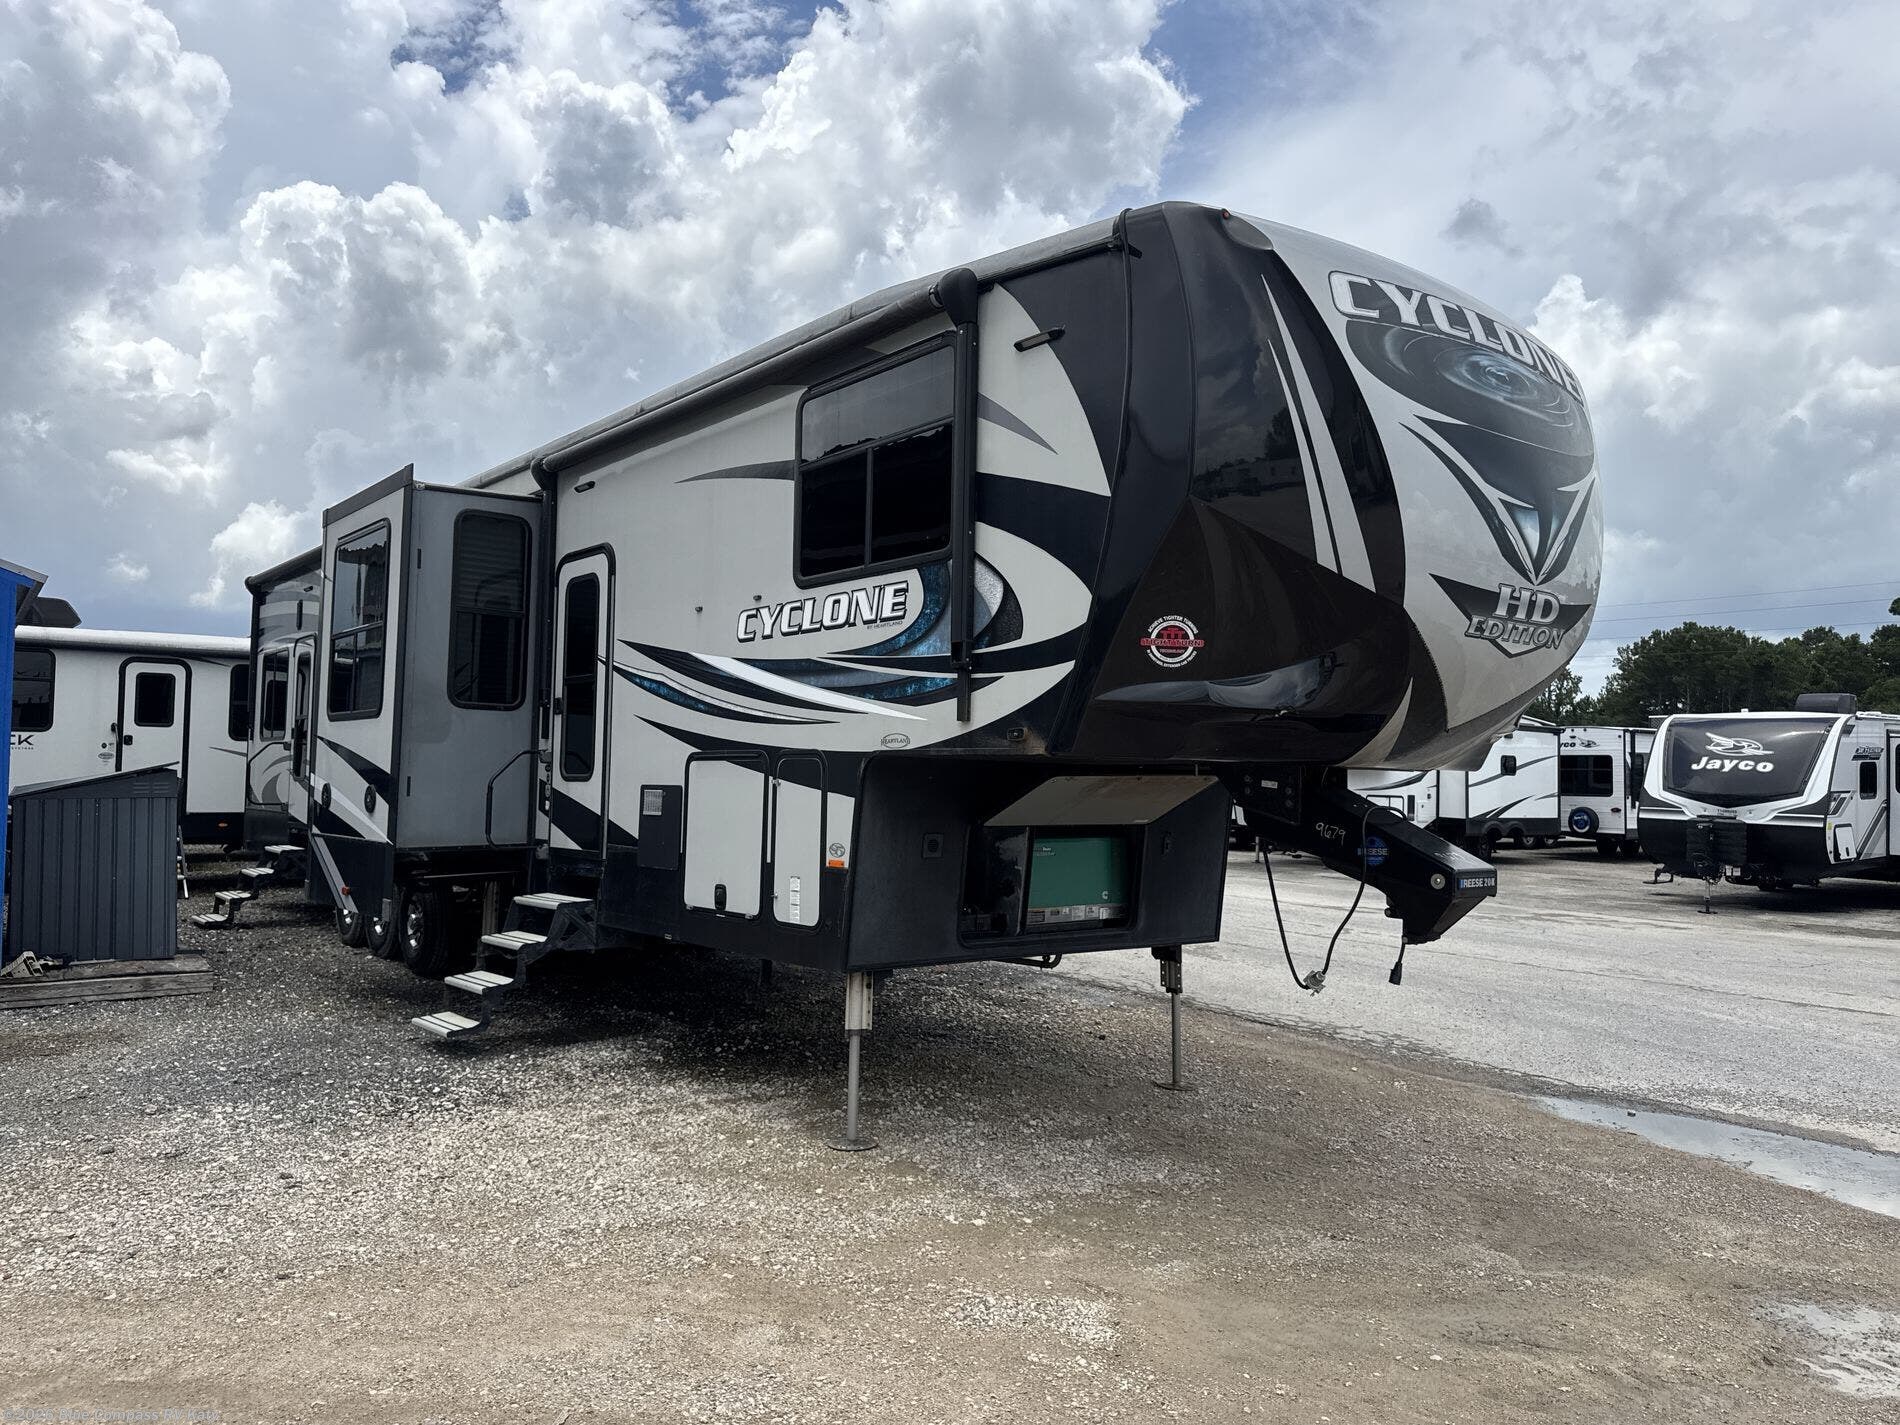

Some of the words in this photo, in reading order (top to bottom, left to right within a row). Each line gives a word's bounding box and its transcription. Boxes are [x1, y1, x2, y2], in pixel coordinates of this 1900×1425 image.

[1328, 270, 1584, 408] CYCLONE
[737, 580, 908, 643] CYCLONE
[1492, 583, 1560, 624] HD
[1464, 615, 1565, 650] EDITION
[1690, 756, 1775, 773] Jayco
[1315, 822, 1347, 847] 9679
[1463, 878, 1484, 888] REESE
